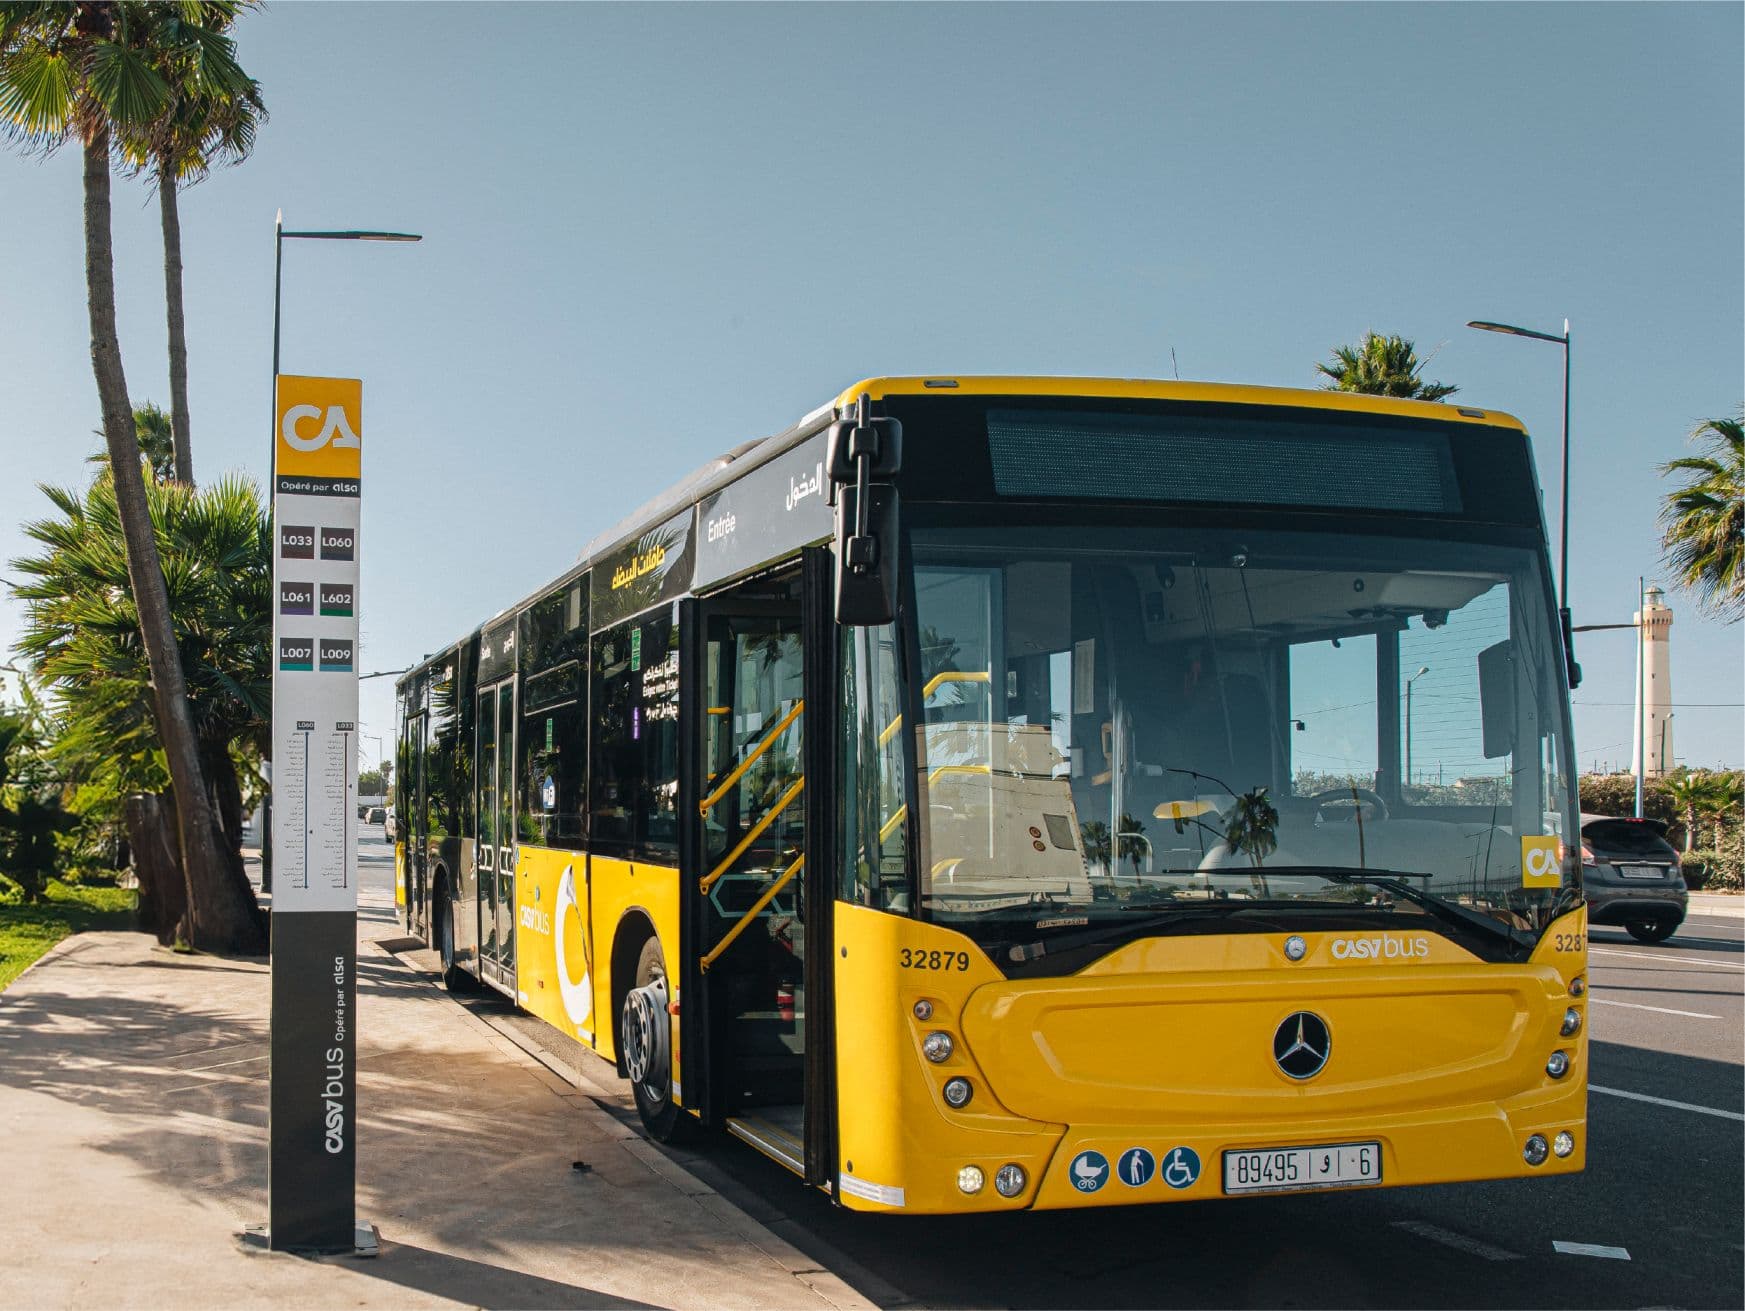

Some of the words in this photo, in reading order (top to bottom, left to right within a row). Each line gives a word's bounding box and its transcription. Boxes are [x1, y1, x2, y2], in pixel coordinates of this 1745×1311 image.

[313, 484, 329, 492] par
[333, 482, 358, 492] alsa
[786, 462, 822, 511] الدخول
[708, 511, 736, 542] Entrée
[282, 535, 312, 546] L033
[322, 537, 352, 548] L060
[282, 592, 311, 603] L061
[321, 593, 351, 604] L602
[281, 648, 311, 659] L007
[321, 649, 351, 660] L009
[333, 956, 344, 985] alsa
[900, 948, 969, 972] 32879
[337, 989, 346, 1007] par
[335, 1009, 346, 1041] Opéré
[1238, 1152, 1297, 1184] 89495
[1360, 1148, 1370, 1175] 6
